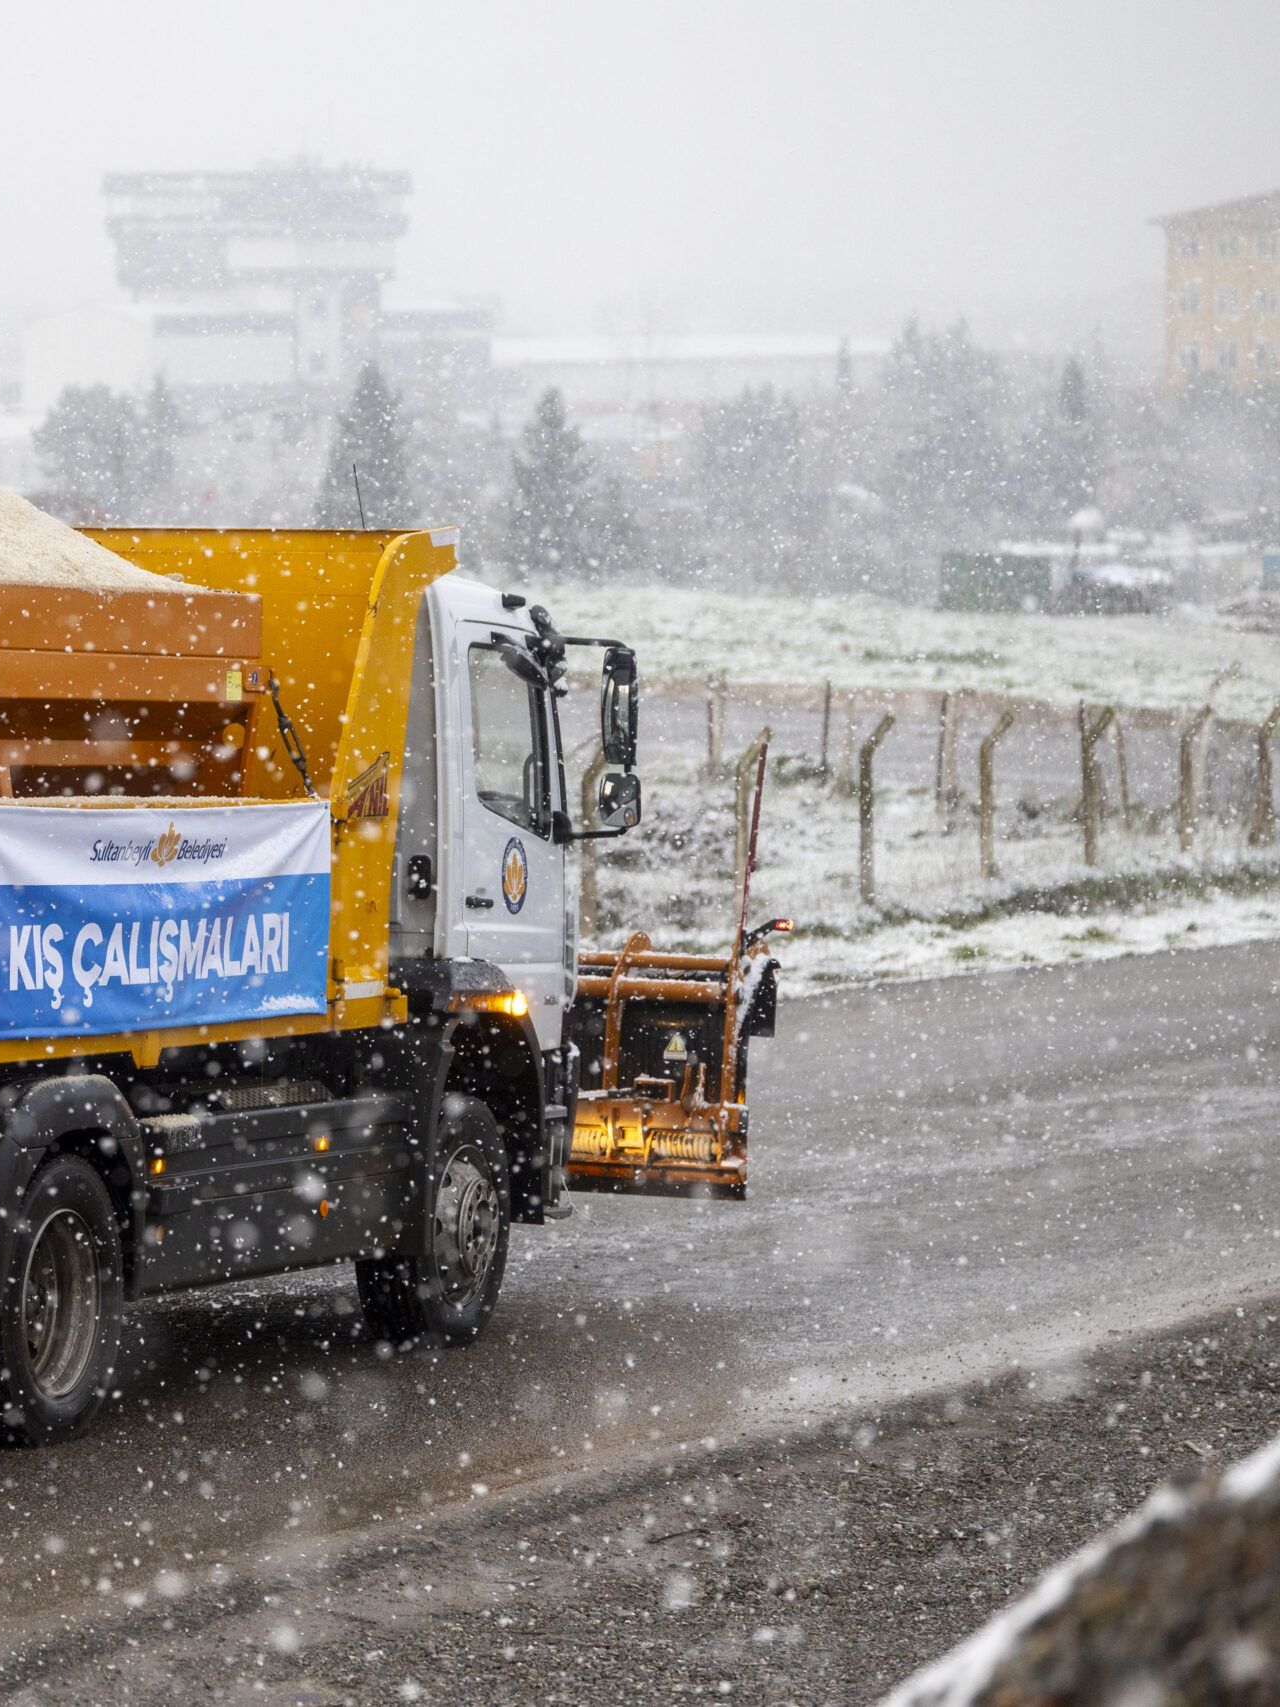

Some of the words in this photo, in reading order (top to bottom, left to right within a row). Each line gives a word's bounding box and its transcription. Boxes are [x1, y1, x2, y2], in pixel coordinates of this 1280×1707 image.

[90, 839, 154, 867] Sultanbeyli
[177, 837, 228, 864] Belediyesi
[9, 923, 65, 1010] KIŞ
[72, 912, 290, 1008] ÇALIŞMALARI
